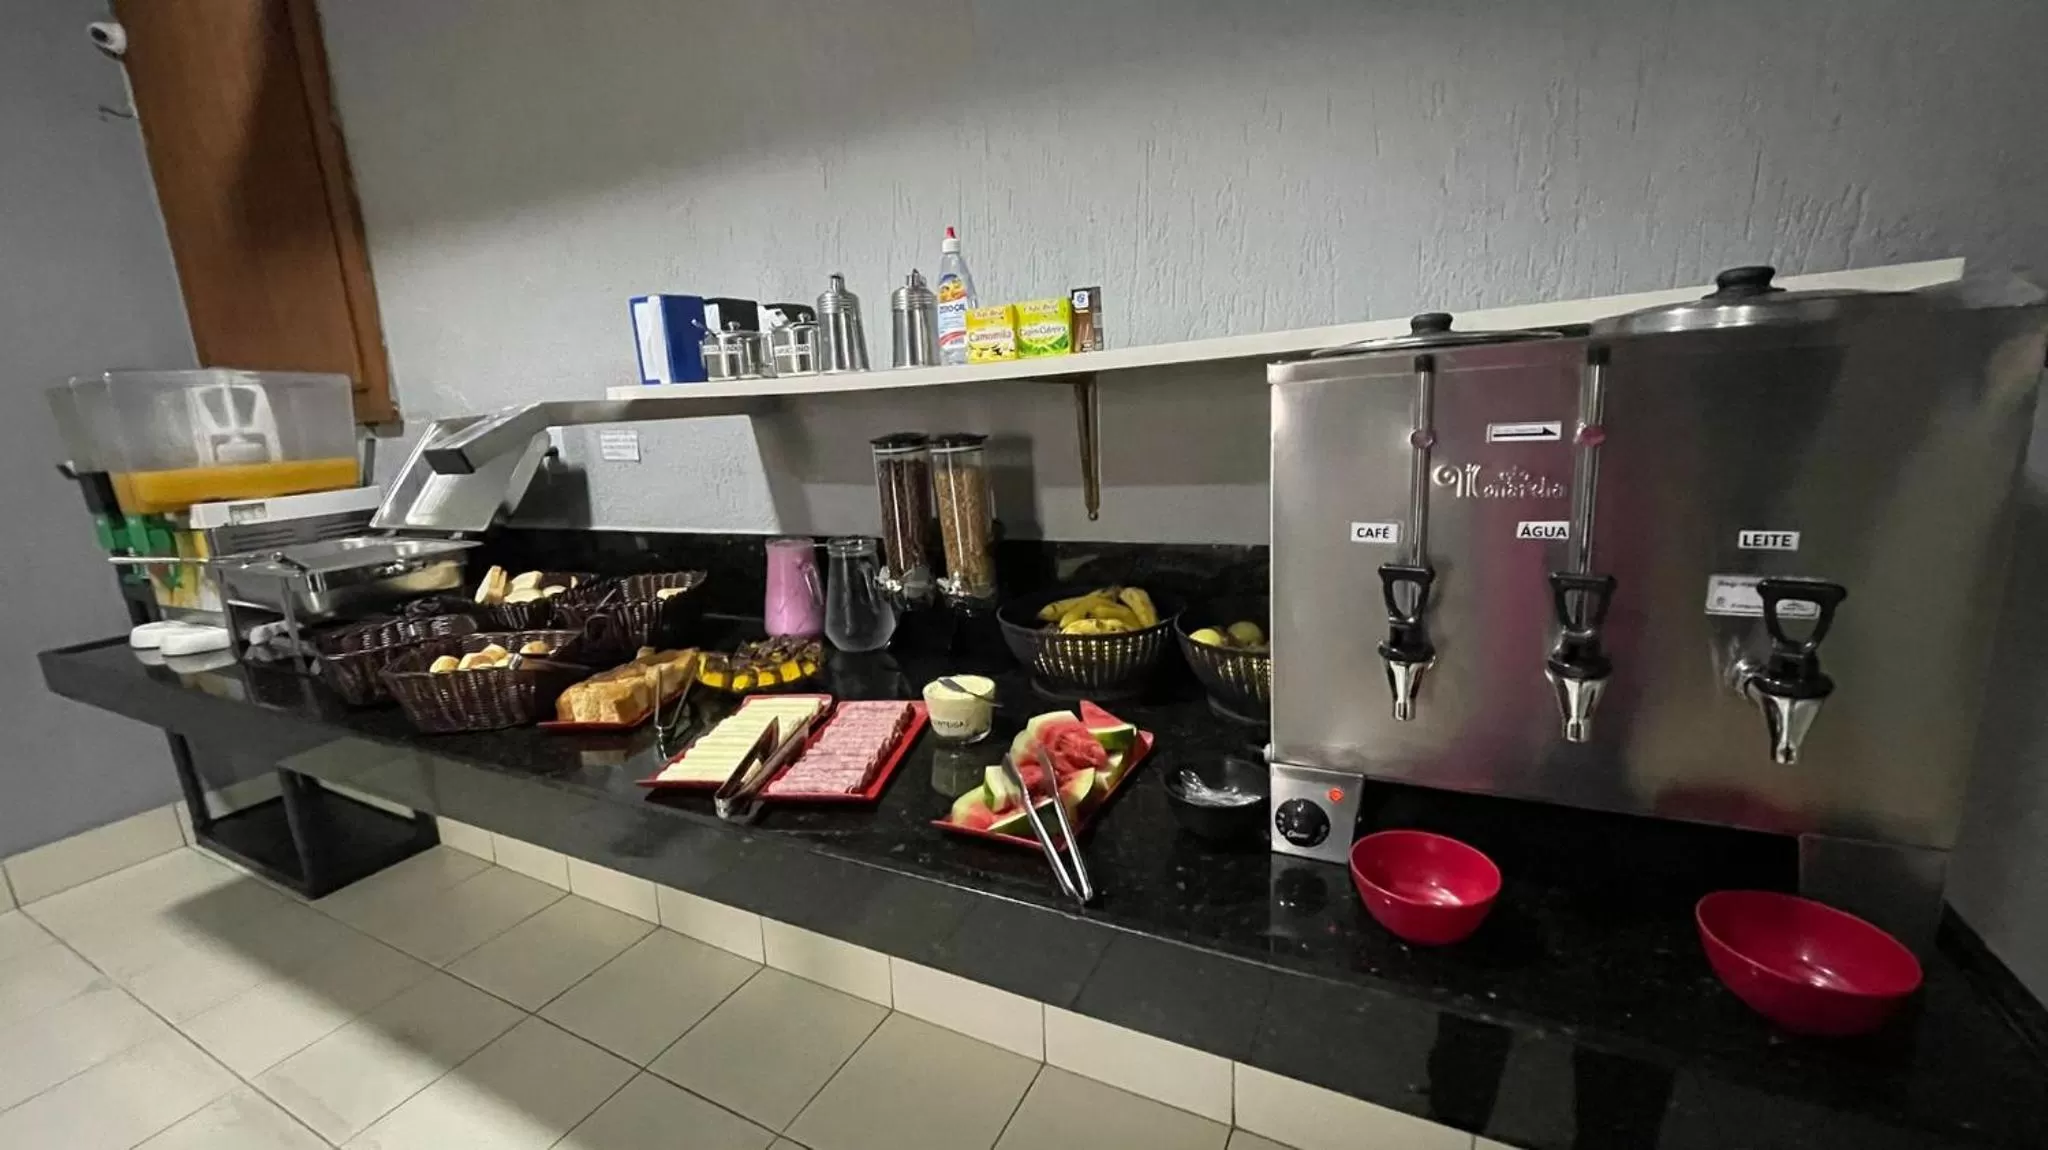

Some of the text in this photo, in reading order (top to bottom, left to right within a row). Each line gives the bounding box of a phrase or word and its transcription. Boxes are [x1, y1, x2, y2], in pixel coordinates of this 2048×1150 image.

[969, 330, 1012, 341] Camomila
[1356, 526, 1390, 539] CAFÉ
[1520, 525, 1567, 538] ÁGUA
[1743, 534, 1793, 547] LEITE
